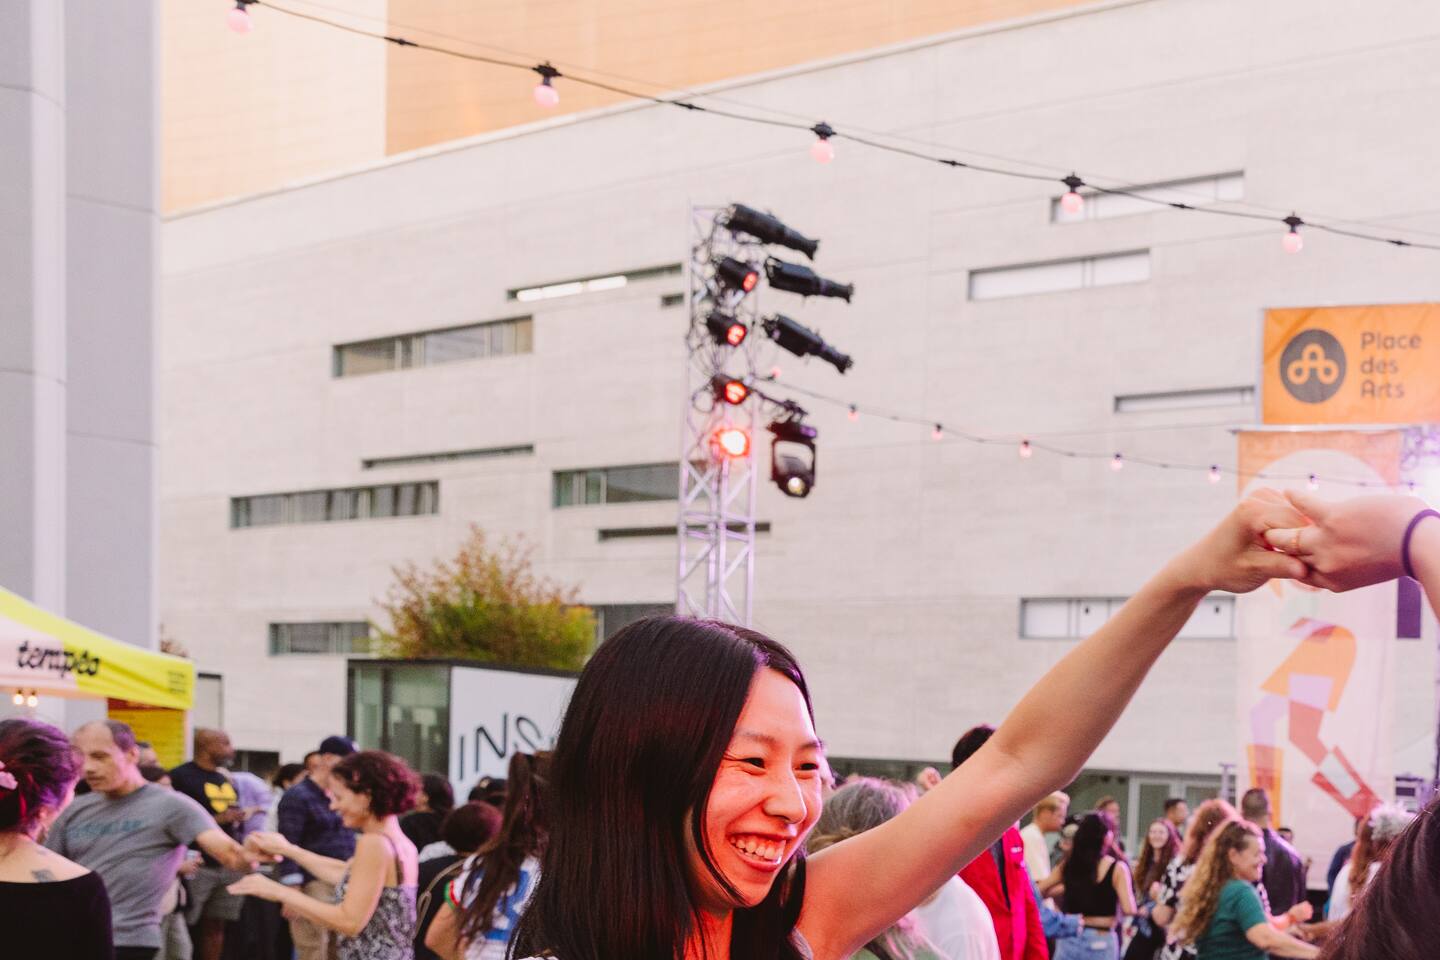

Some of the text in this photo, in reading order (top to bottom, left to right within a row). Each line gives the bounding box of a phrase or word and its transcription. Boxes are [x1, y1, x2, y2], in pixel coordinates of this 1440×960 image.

[1360, 332, 1422, 350] Place
[1360, 357, 1399, 375] des
[1360, 380, 1405, 399] Arts
